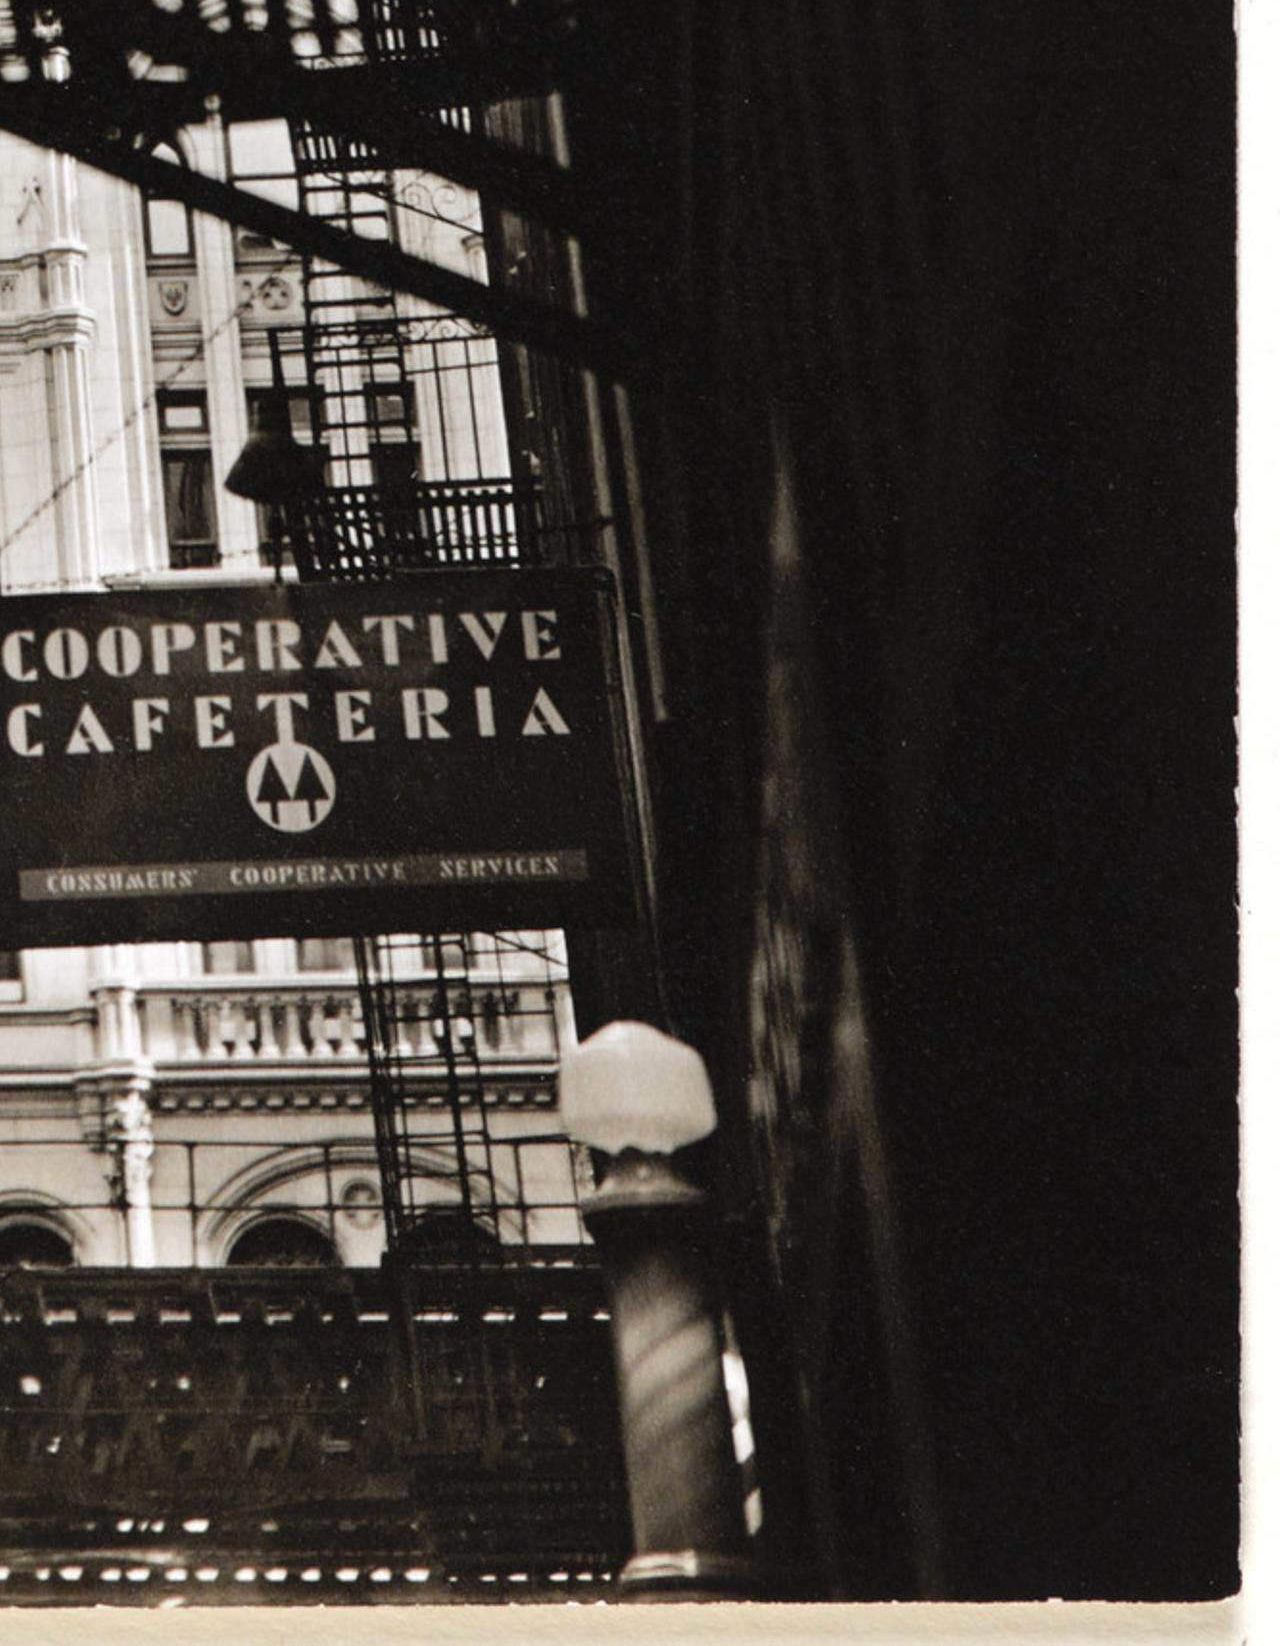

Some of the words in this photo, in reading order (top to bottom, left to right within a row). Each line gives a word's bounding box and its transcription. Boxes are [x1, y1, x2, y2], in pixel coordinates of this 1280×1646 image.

[0, 609, 563, 683] COOPERATIVE
[5, 686, 571, 758] CAFETERIA
[229, 860, 408, 888] COOPERATIVE
[438, 856, 561, 880] SERVICES
